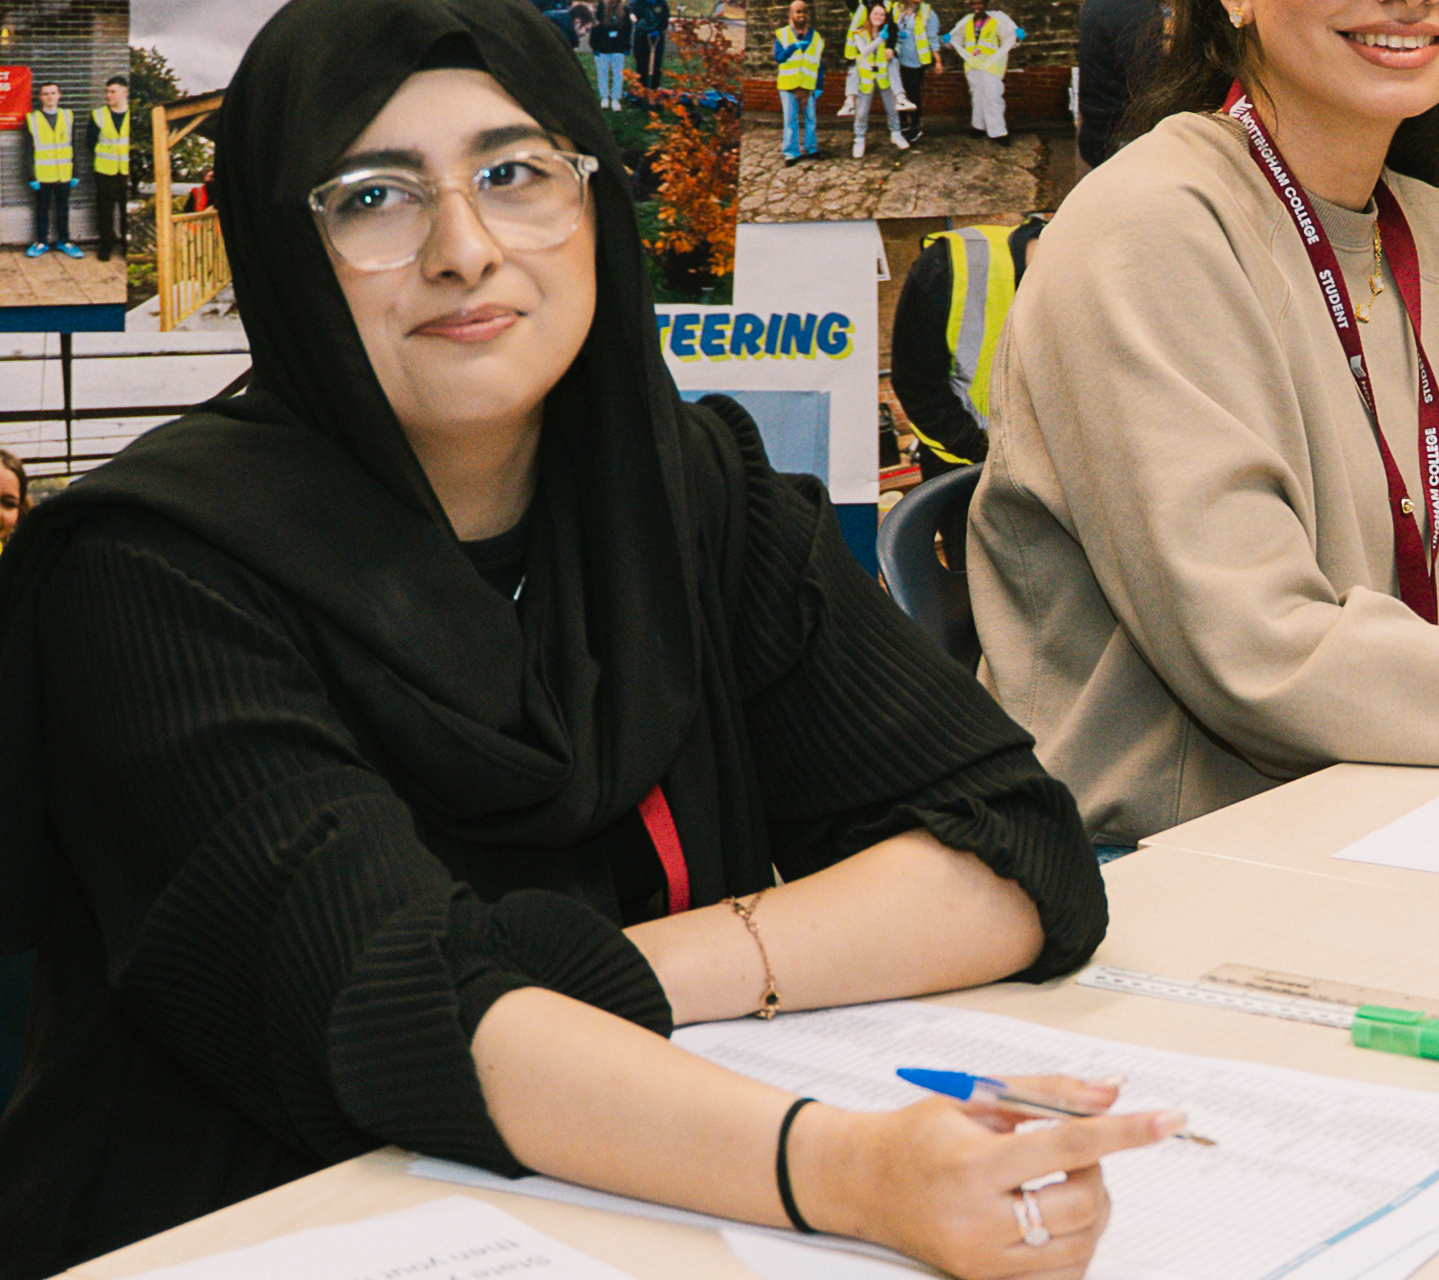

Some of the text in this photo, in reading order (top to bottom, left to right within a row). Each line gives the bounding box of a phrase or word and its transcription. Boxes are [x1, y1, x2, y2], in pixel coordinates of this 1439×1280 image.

[1240, 111, 1320, 246] NOTTINGHAM COLLEGE
[1318, 268, 1349, 329] STUDENT
[1425, 426, 1439, 487] COLLEGE
